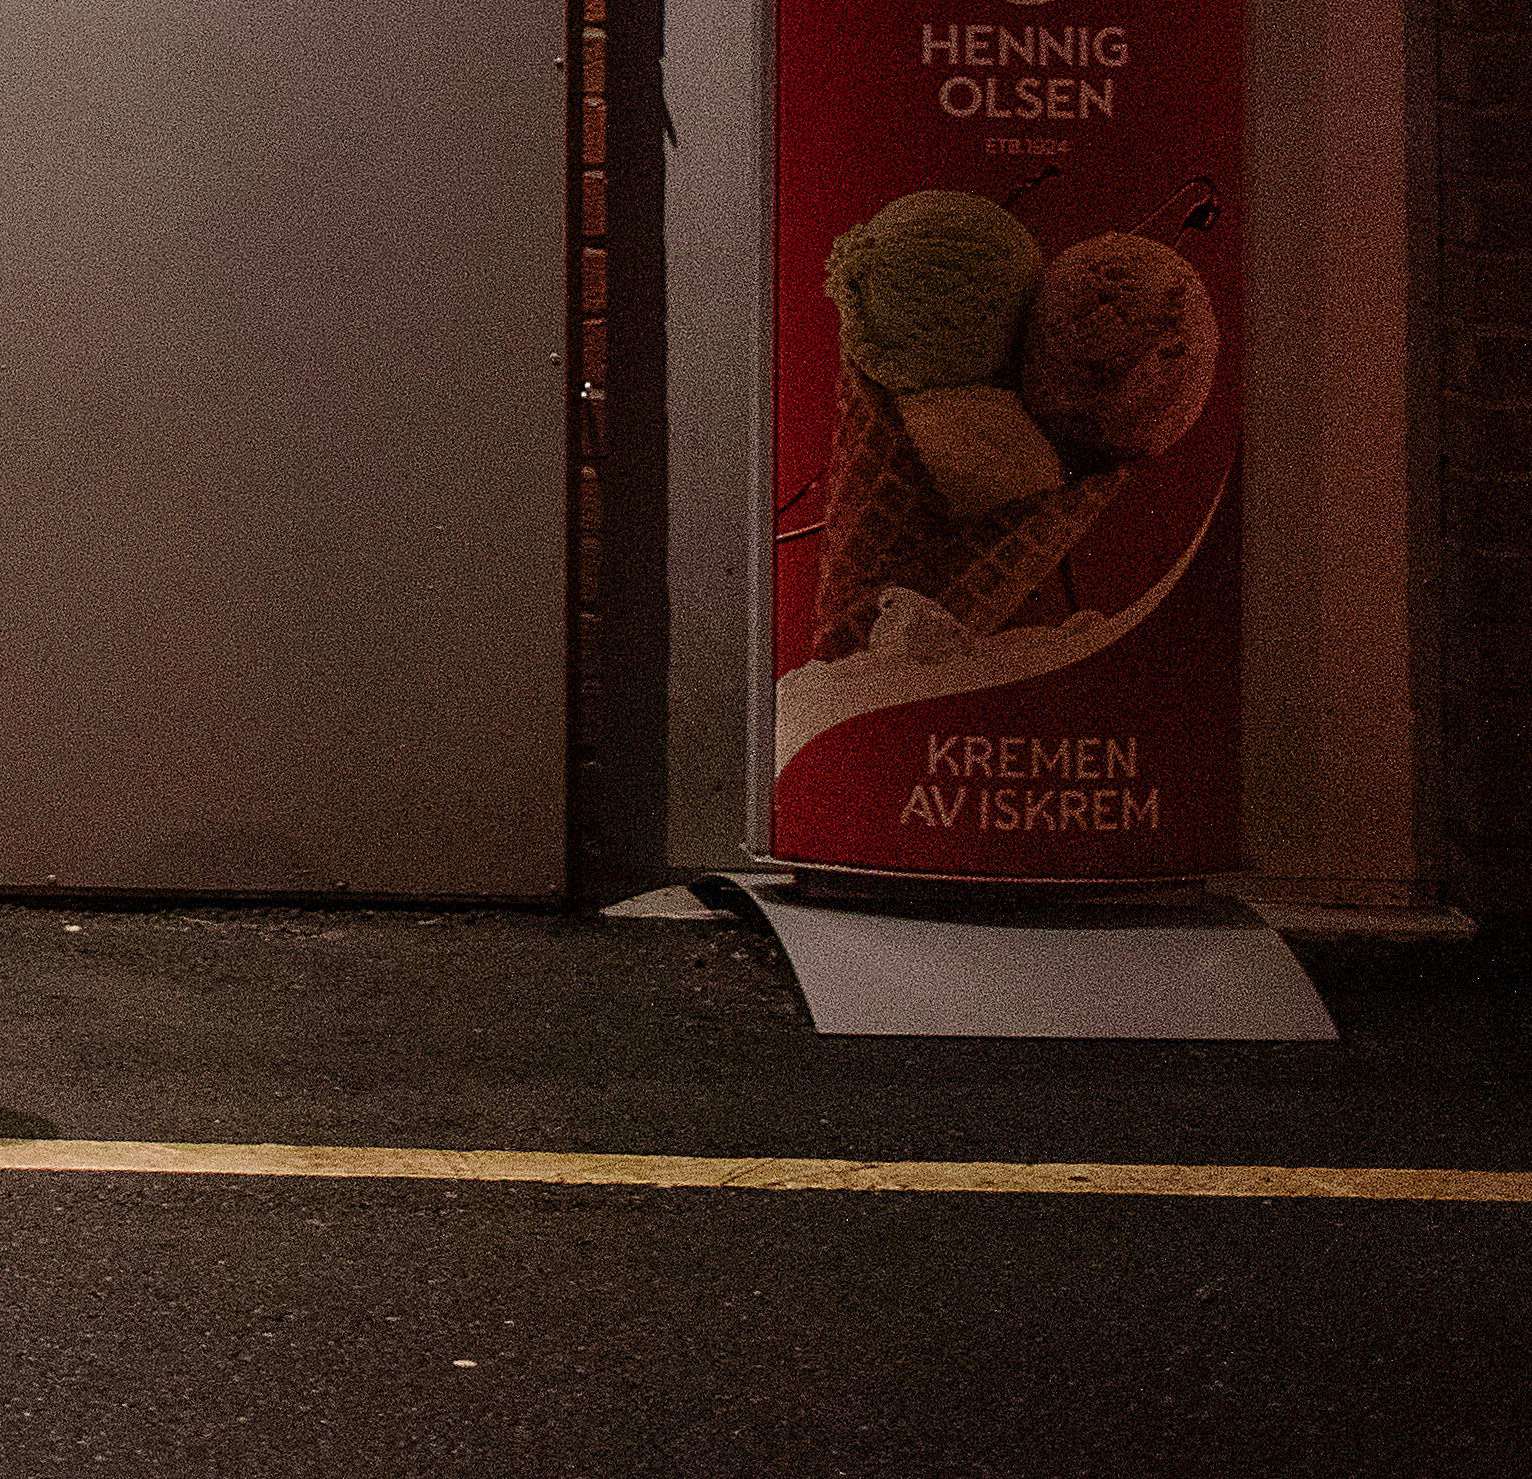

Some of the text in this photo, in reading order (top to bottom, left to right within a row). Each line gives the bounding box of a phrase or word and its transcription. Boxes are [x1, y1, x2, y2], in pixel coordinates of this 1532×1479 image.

[921, 23, 1130, 68] HENNIG
[938, 75, 1114, 120] OLSEN
[927, 732, 1138, 779] KREMEN
[899, 783, 1160, 831] AV ISKREM
